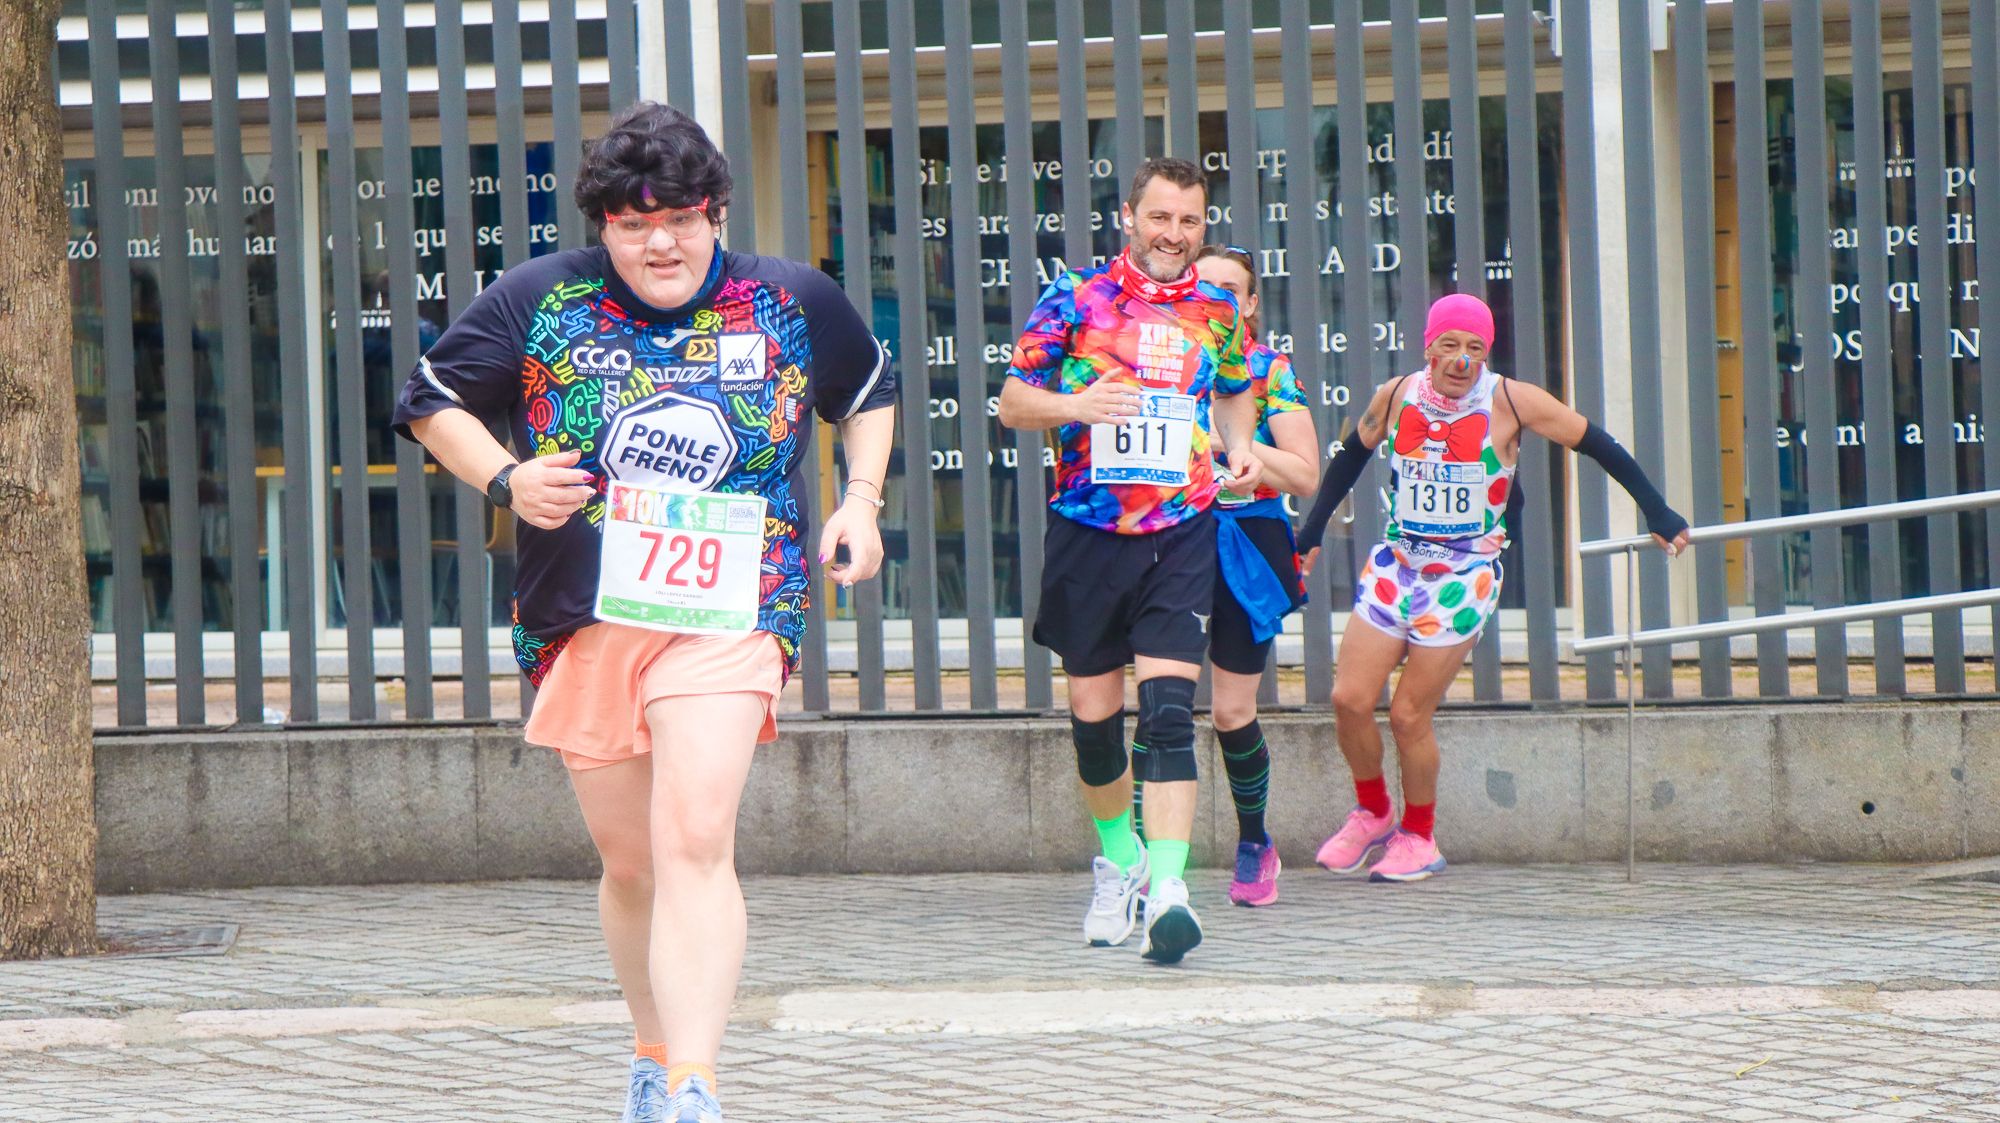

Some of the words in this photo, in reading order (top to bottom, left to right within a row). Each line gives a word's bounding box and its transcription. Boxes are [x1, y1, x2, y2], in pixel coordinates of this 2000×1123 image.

[722, 358, 757, 376] AXA
[720, 382, 764, 392] fundación
[628, 423, 720, 464] PONLE
[1115, 421, 1167, 456] 611
[618, 446, 708, 484] FRENO
[623, 489, 671, 527] 10K
[1409, 483, 1471, 513] 1318
[638, 530, 724, 590] 729
